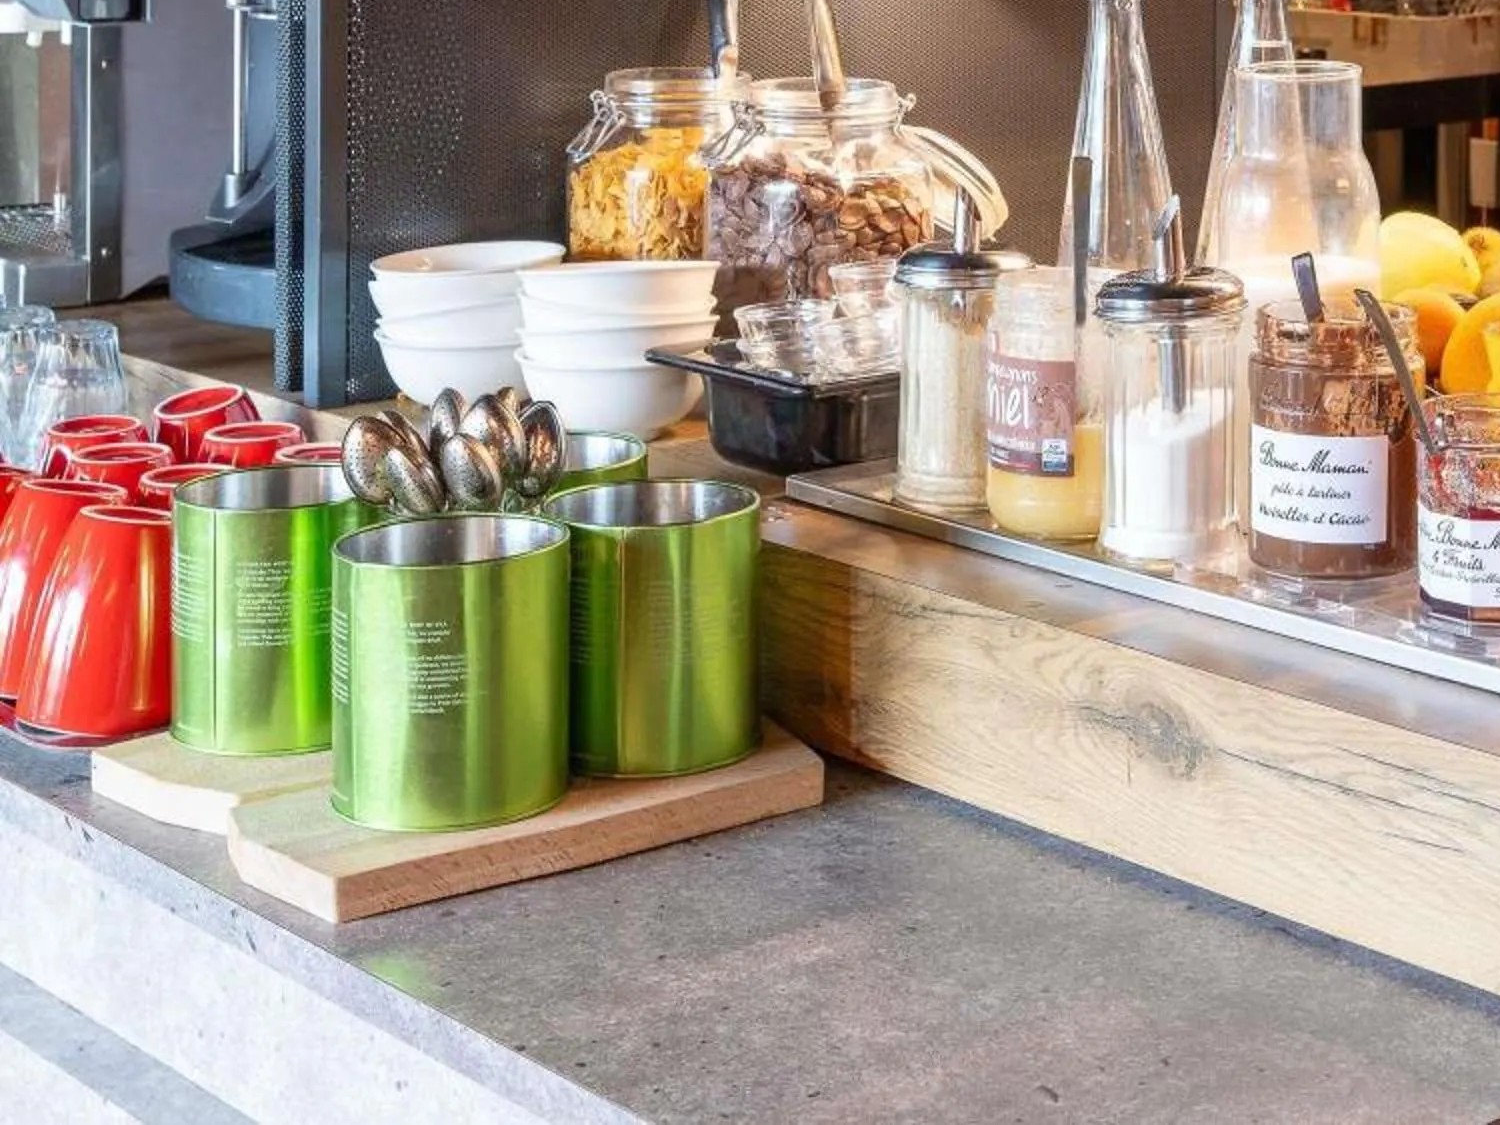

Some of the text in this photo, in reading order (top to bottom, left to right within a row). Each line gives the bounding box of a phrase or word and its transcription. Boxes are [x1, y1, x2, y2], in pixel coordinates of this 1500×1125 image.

[1259, 440, 1369, 474] Bonne Maman
[1307, 485, 1351, 500] tartiner
[1312, 512, 1327, 525] et
[1328, 512, 1371, 526] Cacao
[1436, 519, 1481, 550] Bonne
[1442, 549, 1485, 571] Fruits
